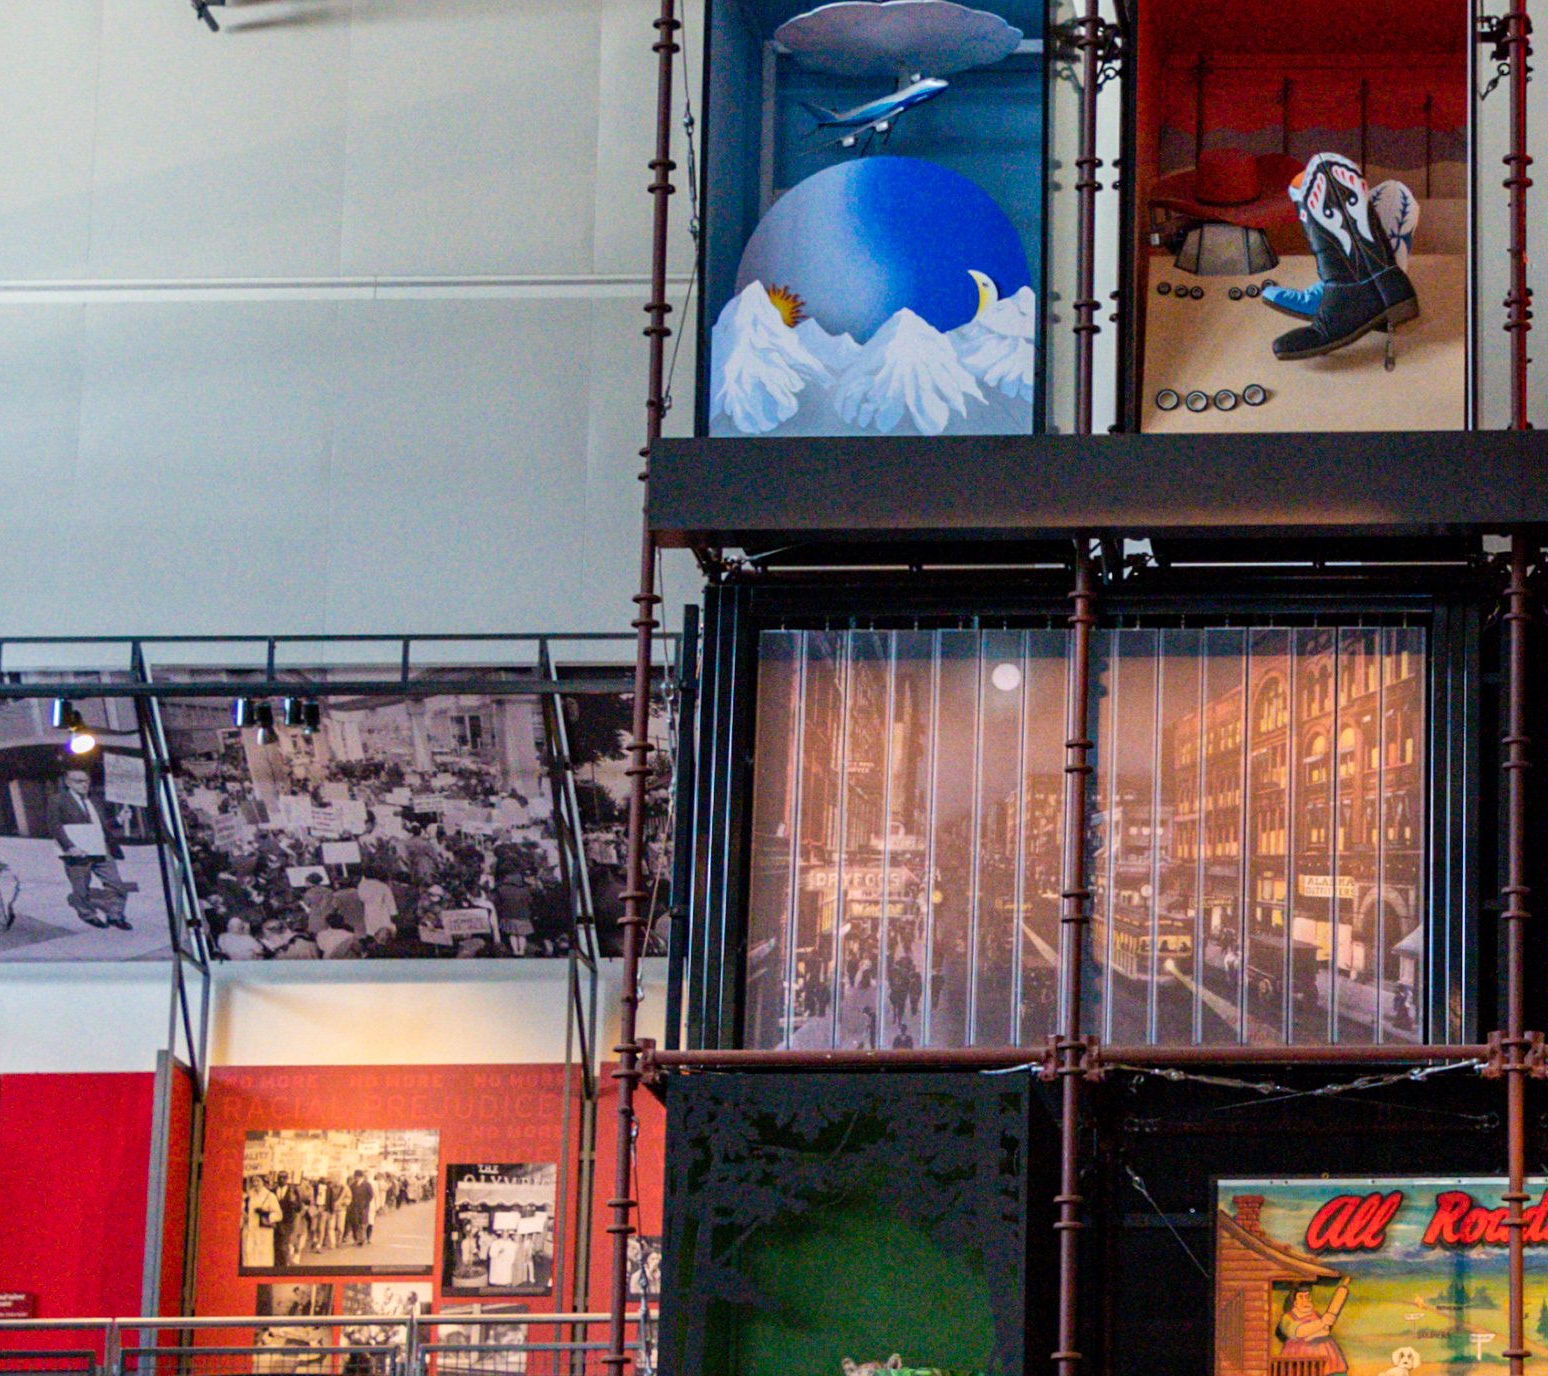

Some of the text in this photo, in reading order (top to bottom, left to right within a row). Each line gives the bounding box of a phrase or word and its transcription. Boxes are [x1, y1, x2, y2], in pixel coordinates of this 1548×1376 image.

[223, 1095, 345, 1120] RACIAL
[478, 1164, 499, 1174] THE
[1306, 1190, 1403, 1252] All
